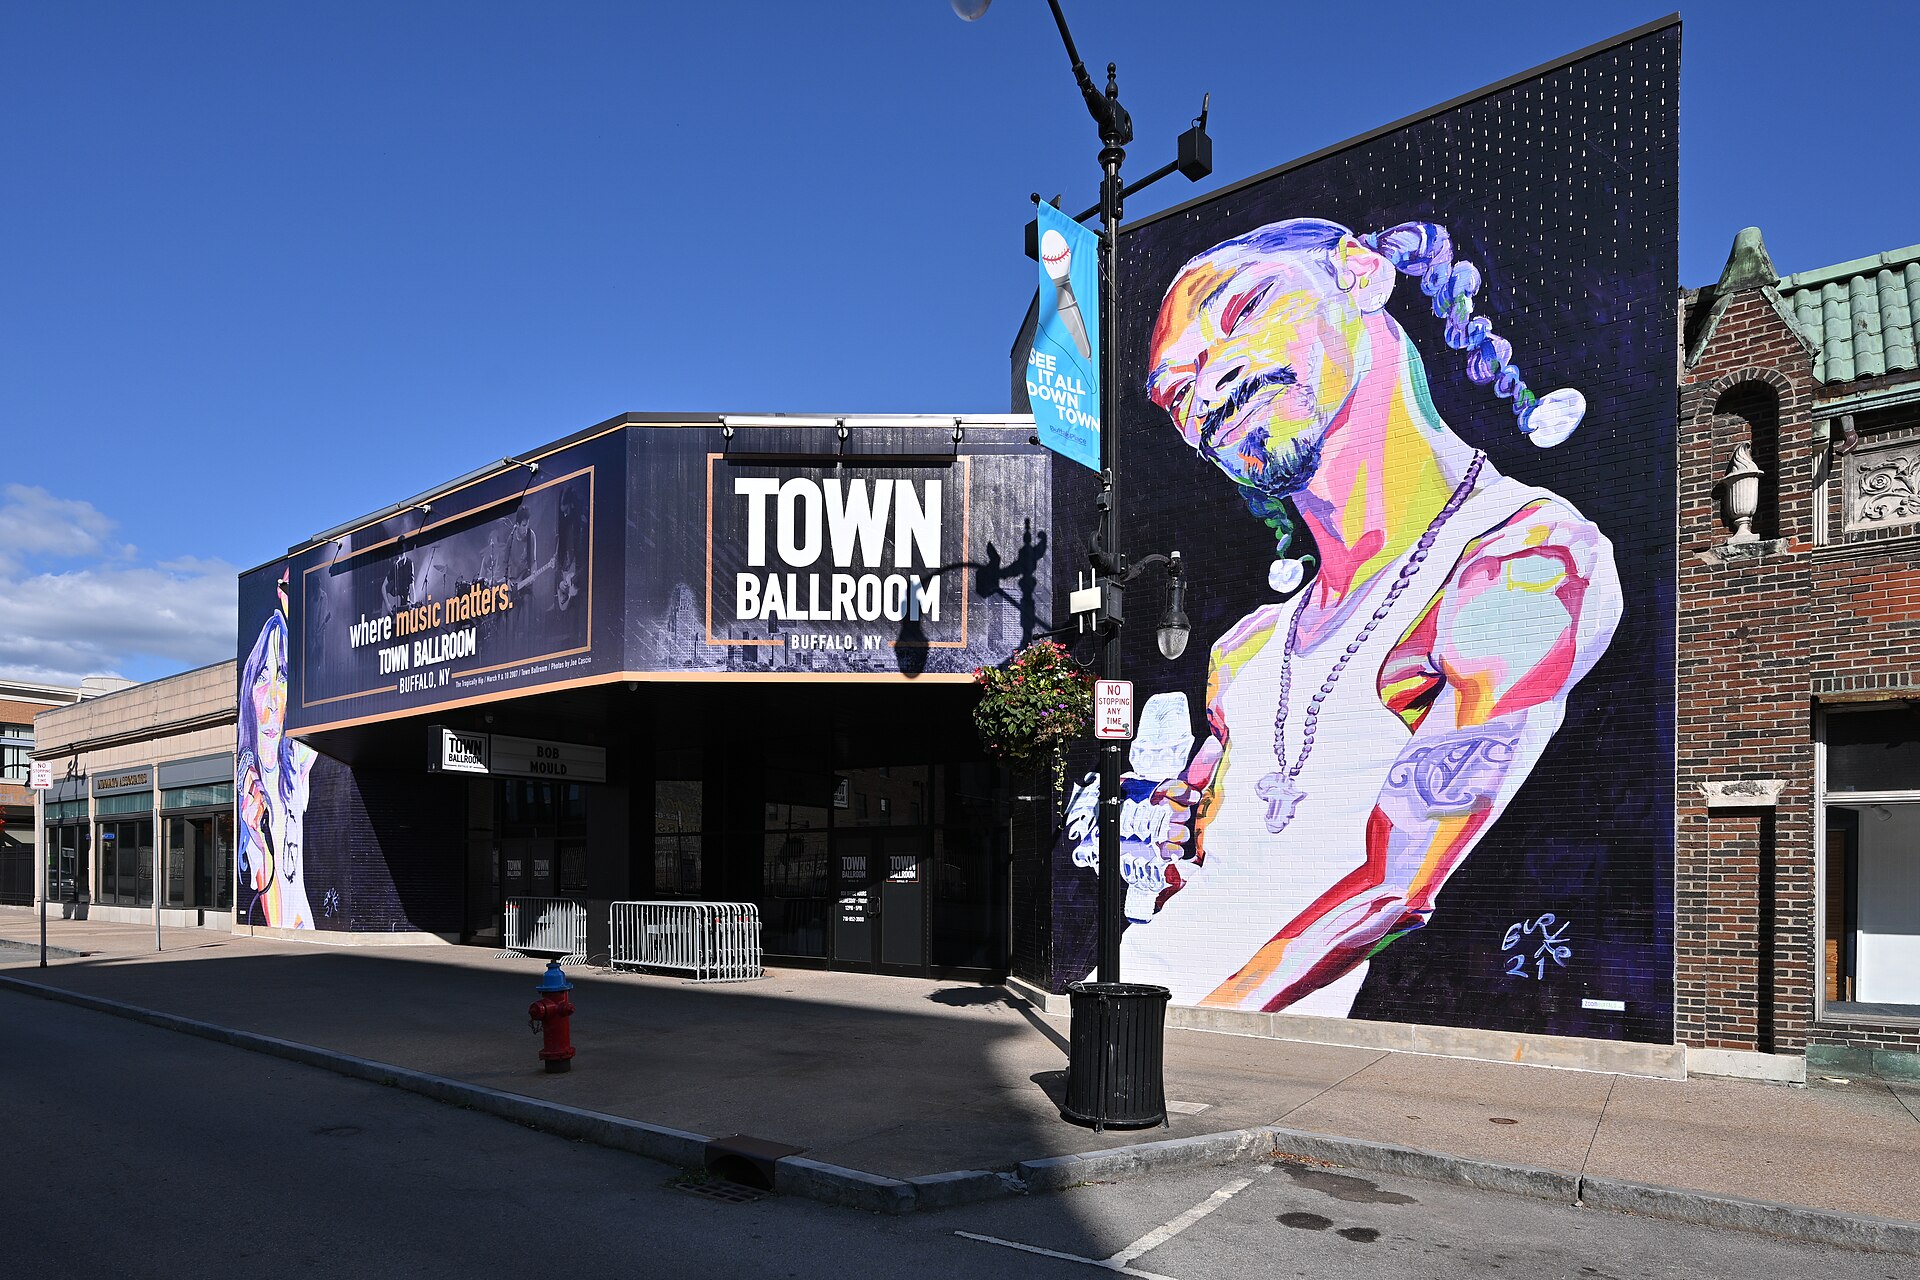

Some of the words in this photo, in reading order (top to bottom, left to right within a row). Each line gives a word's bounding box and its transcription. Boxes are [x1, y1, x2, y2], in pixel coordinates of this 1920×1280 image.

[1029, 347, 1056, 372] SEE
[1038, 368, 1054, 386] IT
[1054, 374, 1086, 395] ALL
[1026, 380, 1079, 409] DOWN
[1055, 404, 1100, 433] TOWN
[734, 477, 942, 568] TOWN
[736, 573, 941, 622] BALLROOM
[350, 613, 391, 648] where
[396, 594, 441, 637] music
[446, 583, 513, 624] matters.
[791, 634, 858, 650] BUFFALO,
[864, 635, 882, 650] NY
[378, 643, 409, 675] TOWN
[414, 627, 476, 668] BALLROOM
[521, 668, 530, 676] Town
[531, 665, 547, 674] Ballroom
[551, 662, 564, 670] Photos
[565, 660, 570, 668] by
[399, 671, 437, 694] BUFFALO,
[439, 668, 451, 687] NY
[1107, 685, 1121, 696] NO
[1098, 697, 1130, 706] STOPPING
[1107, 707, 1121, 715] ANY
[1106, 717, 1122, 725] TIME
[448, 737, 482, 755] TOWN
[537, 745, 559, 759] BOB
[448, 753, 482, 764] BALLROOM
[530, 761, 567, 775] MOULD
[506, 859, 522, 871] TOWN
[534, 859, 549, 871] TOWN
[841, 856, 866, 870] TOWN
[890, 856, 916, 870] TOWN
[841, 870, 866, 879] BALLROOM
[890, 870, 916, 879] BALLROOM
